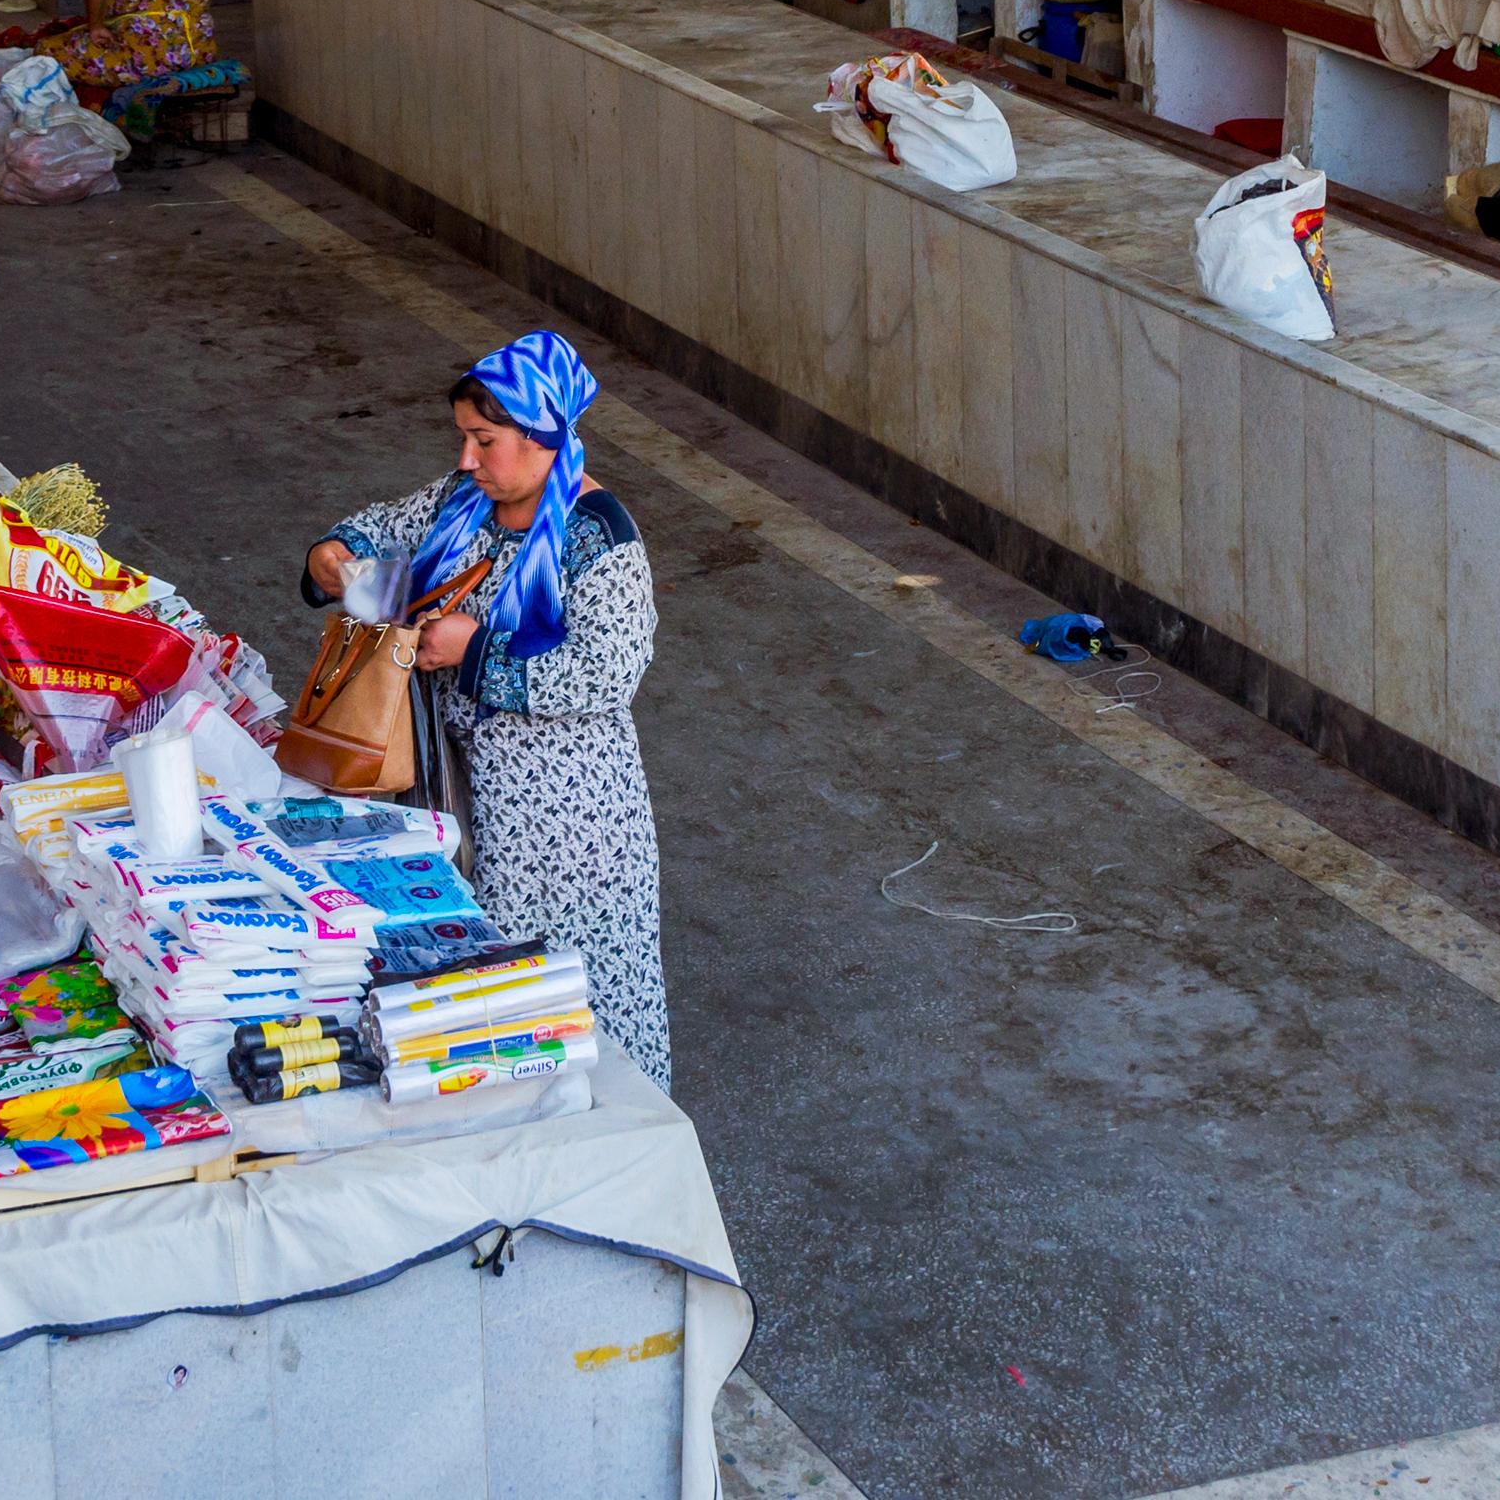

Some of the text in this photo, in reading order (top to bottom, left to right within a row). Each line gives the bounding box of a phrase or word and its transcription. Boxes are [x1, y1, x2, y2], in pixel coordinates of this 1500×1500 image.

[256, 844, 326, 893] Faravon
[197, 911, 309, 934] Faravon
[516, 1060, 554, 1076] Silver
